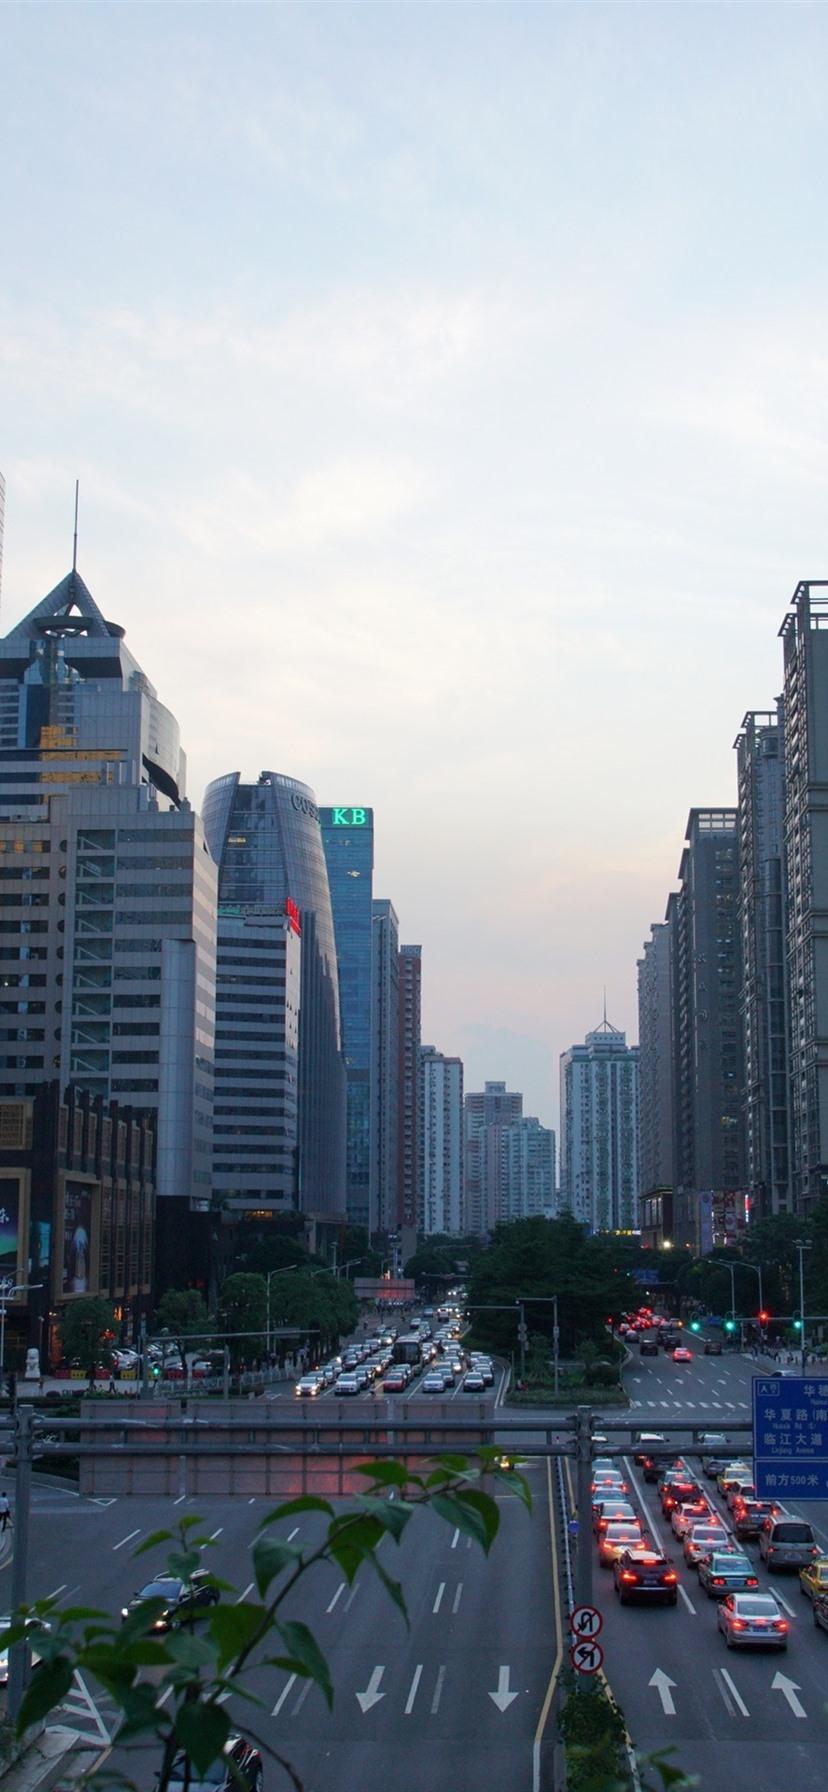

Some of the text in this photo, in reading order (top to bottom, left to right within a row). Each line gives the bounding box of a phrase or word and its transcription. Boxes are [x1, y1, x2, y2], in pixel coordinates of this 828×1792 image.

[332, 808, 366, 825] KB
[764, 1433, 822, 1446] 临江大道
[765, 1473, 819, 1487] 前方500米
